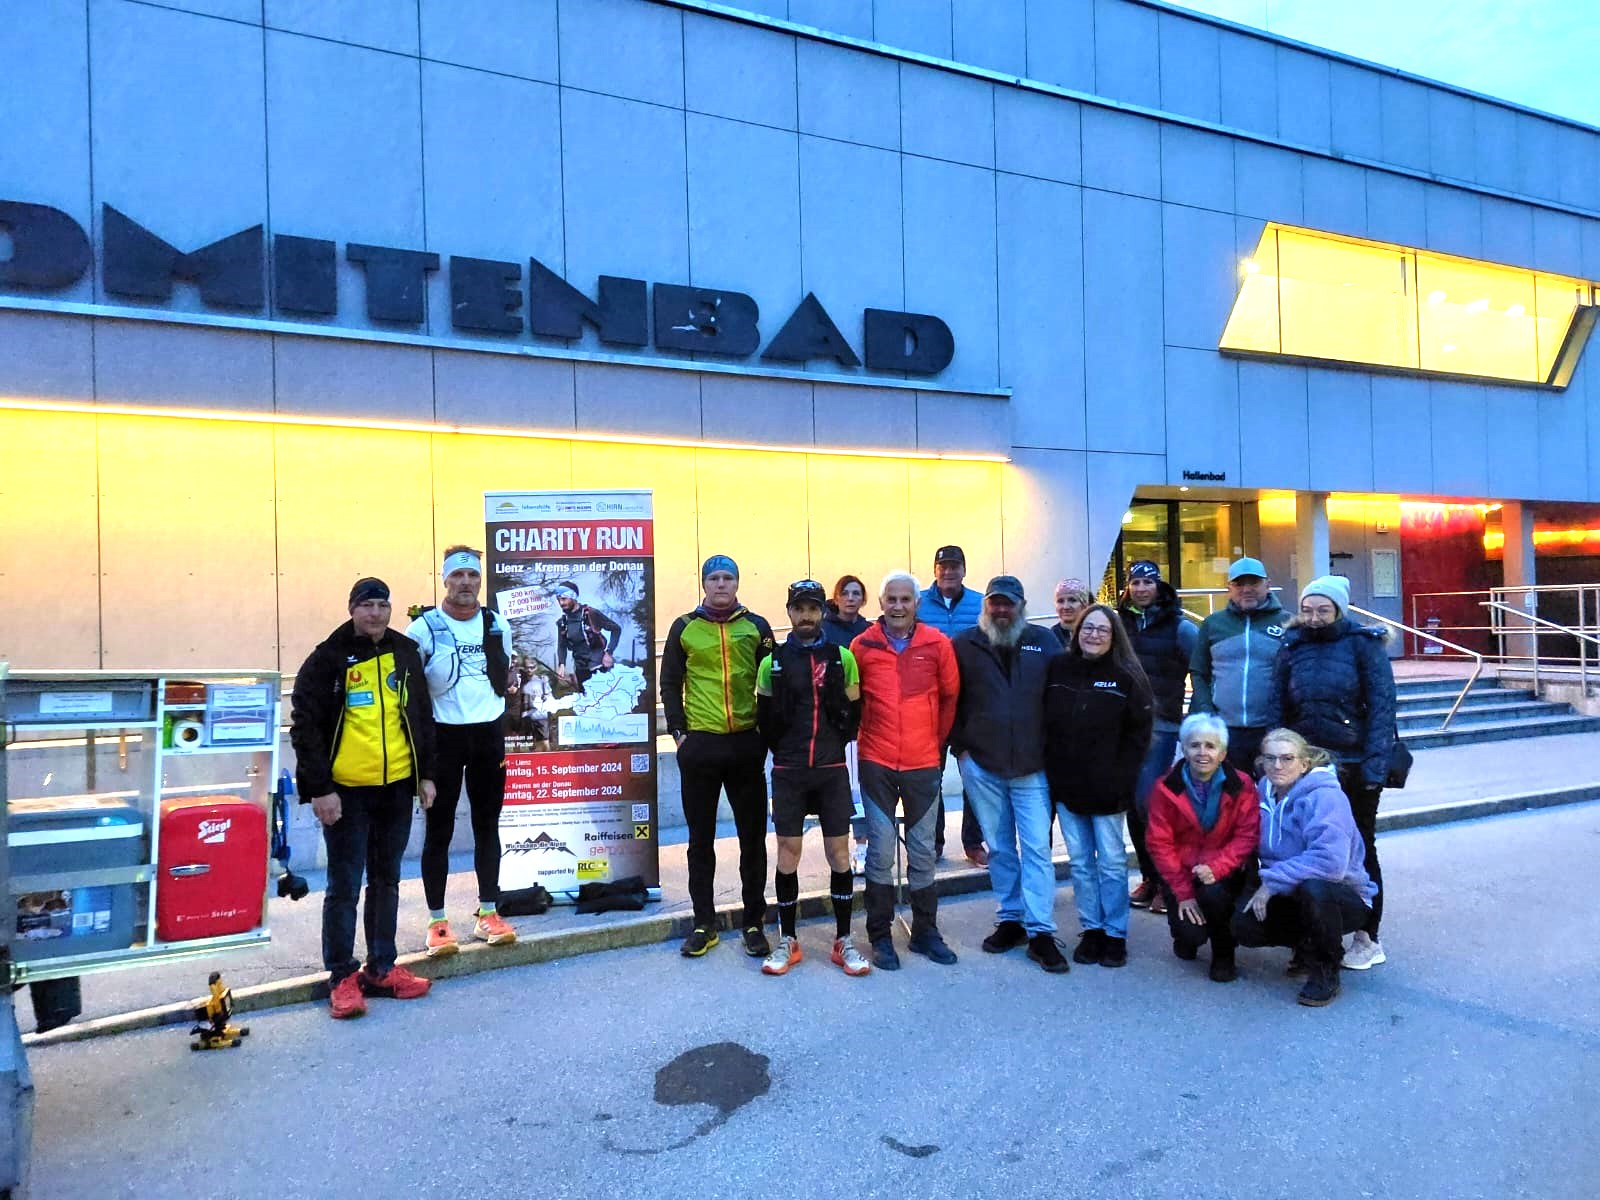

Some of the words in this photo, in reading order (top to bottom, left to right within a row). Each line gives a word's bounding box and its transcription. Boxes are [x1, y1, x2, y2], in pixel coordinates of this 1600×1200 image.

[1183, 470, 1225, 481] Hallenbad
[495, 527, 591, 552] CHARITY
[596, 527, 643, 550] RUN
[496, 563, 523, 574] Lienz
[535, 562, 569, 573] Krems
[572, 564, 585, 572] an
[589, 561, 606, 572] der
[609, 561, 644, 571] Donau
[456, 644, 486, 653] TERR
[506, 766, 534, 778] nntag,
[536, 765, 550, 775] 15.
[551, 763, 599, 776] September
[601, 762, 622, 773] 2024
[552, 780, 572, 788] Donau
[536, 789, 550, 799] 22.
[552, 787, 599, 799] September
[601, 785, 622, 796] 2024
[198, 818, 231, 839] Stiegl
[584, 831, 633, 841] Raiffeisen
